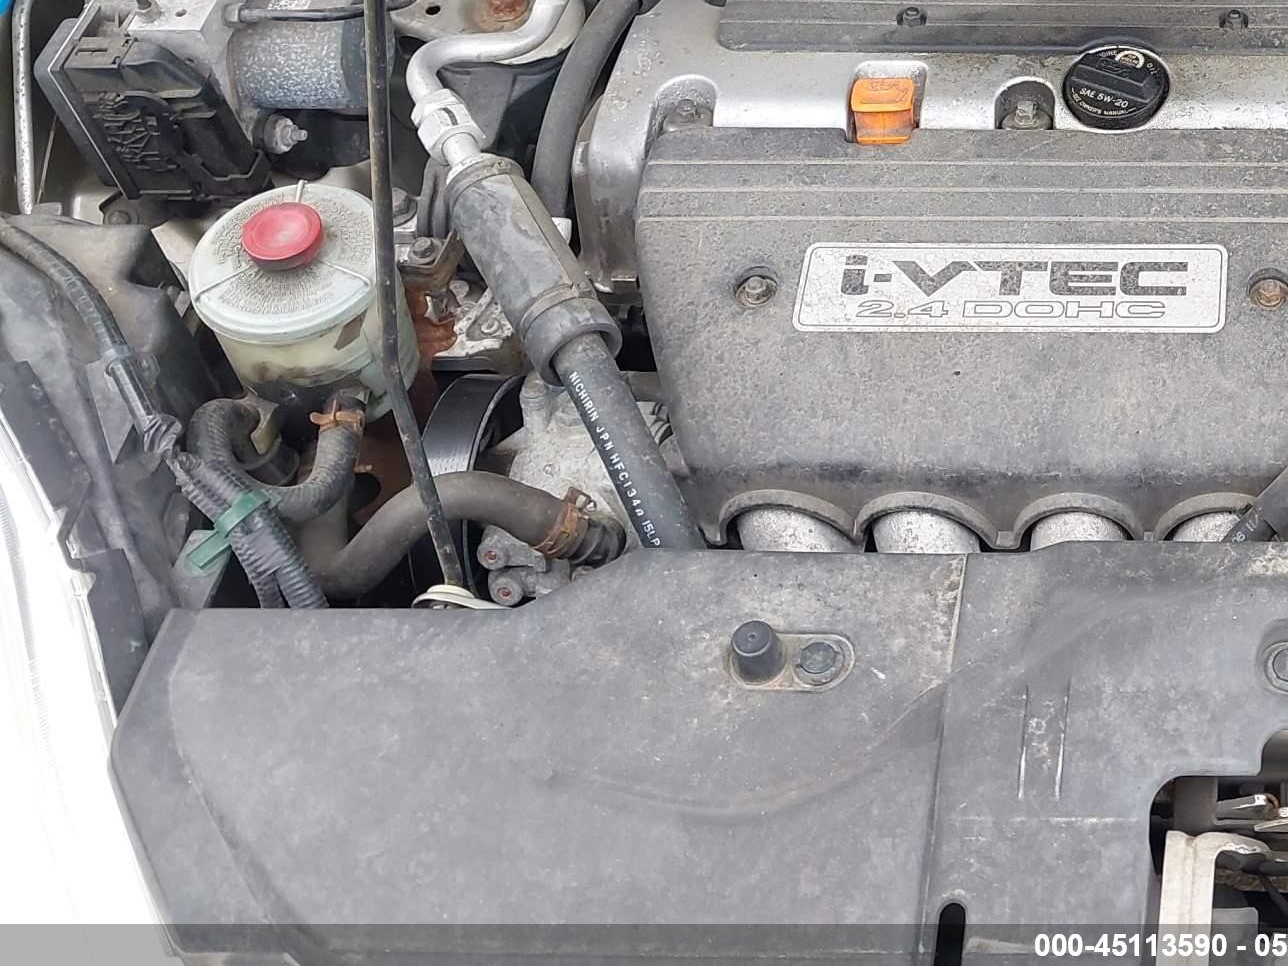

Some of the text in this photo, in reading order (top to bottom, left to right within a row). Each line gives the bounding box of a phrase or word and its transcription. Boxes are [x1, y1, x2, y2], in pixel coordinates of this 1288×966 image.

[1079, 87, 1129, 109] SAE 5W-20
[839, 254, 1188, 297] i-VTEC
[856, 300, 1167, 320] 2.4 DOHC
[568, 371, 599, 422] NICHIRIN
[595, 425, 615, 451] JPN
